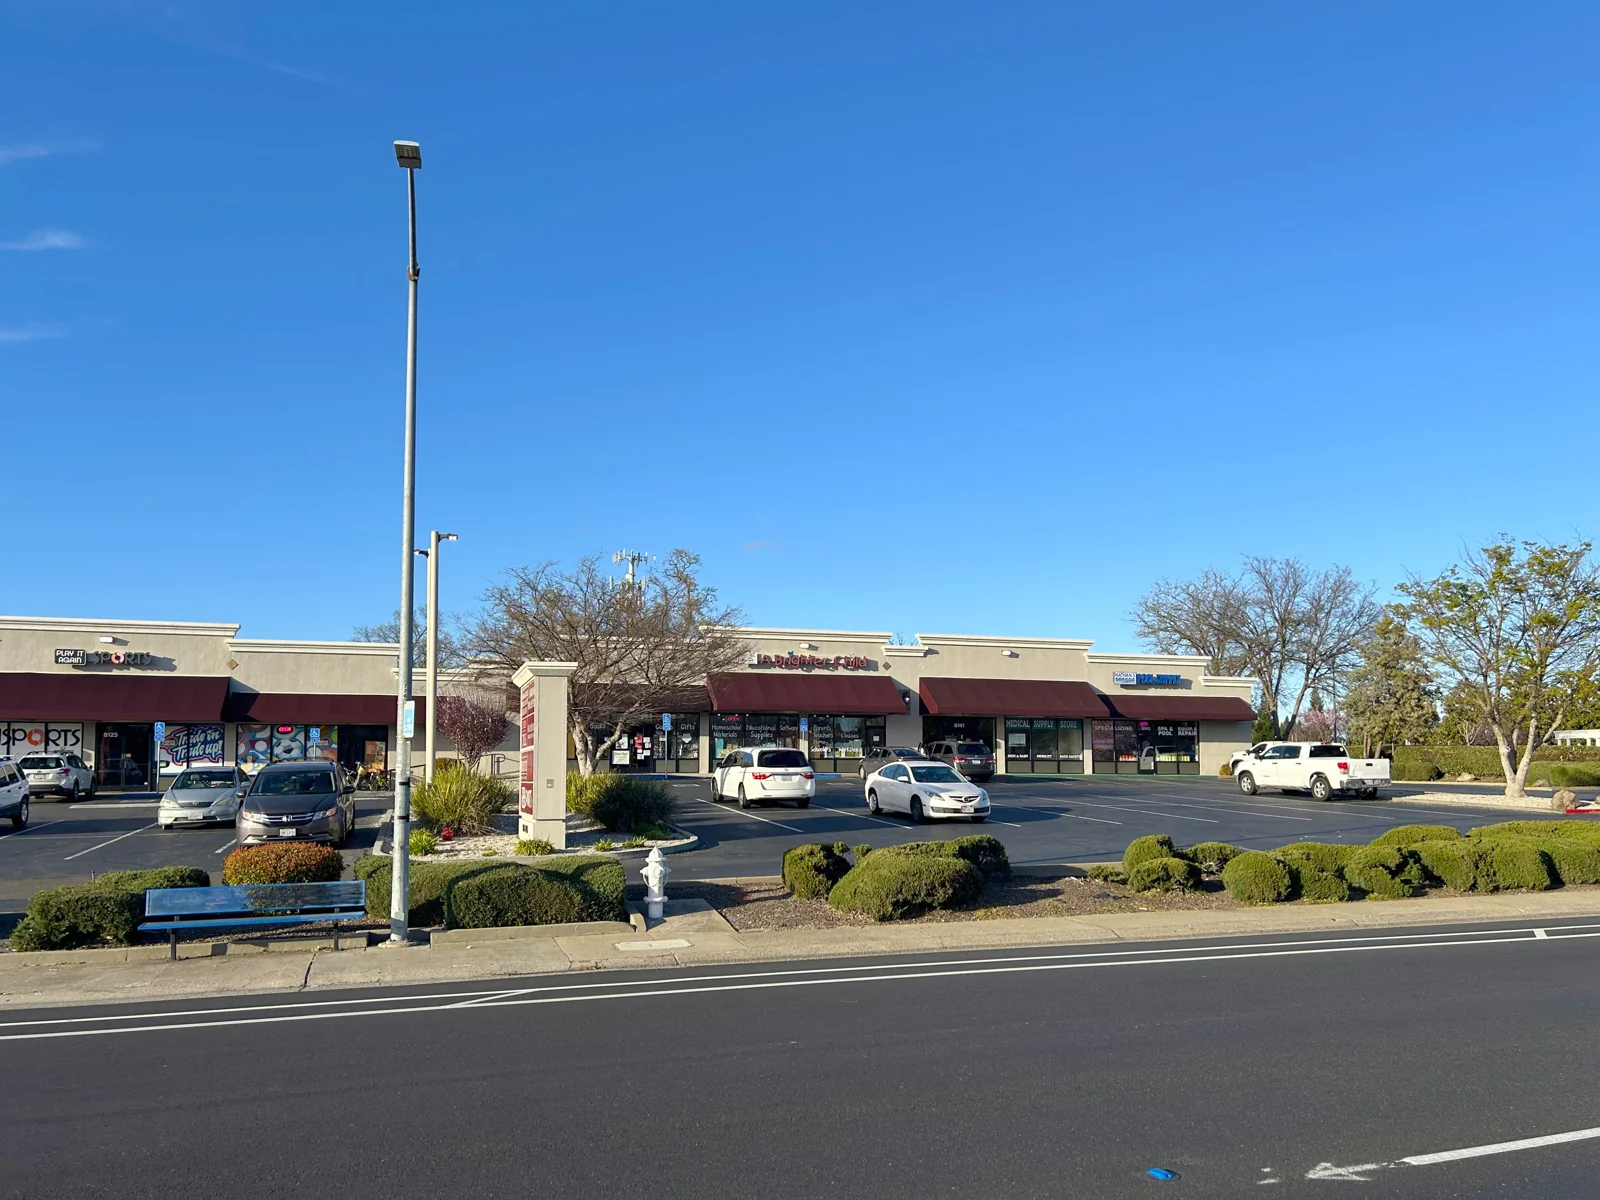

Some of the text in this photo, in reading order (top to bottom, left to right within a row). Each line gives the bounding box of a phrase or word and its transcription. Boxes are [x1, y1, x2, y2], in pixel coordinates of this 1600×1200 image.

[58, 656, 82, 664] AGAIN
[93, 651, 152, 665] SPORTS
[760, 653, 867, 668] A Brighter Child
[1136, 673, 1182, 685] POOL SUPPLY
[1006, 719, 1078, 728] MEDICAL SUPPLY STORE
[0, 728, 81, 747] SPORTS
[175, 729, 206, 747] Trade
[172, 743, 205, 761] Trade
